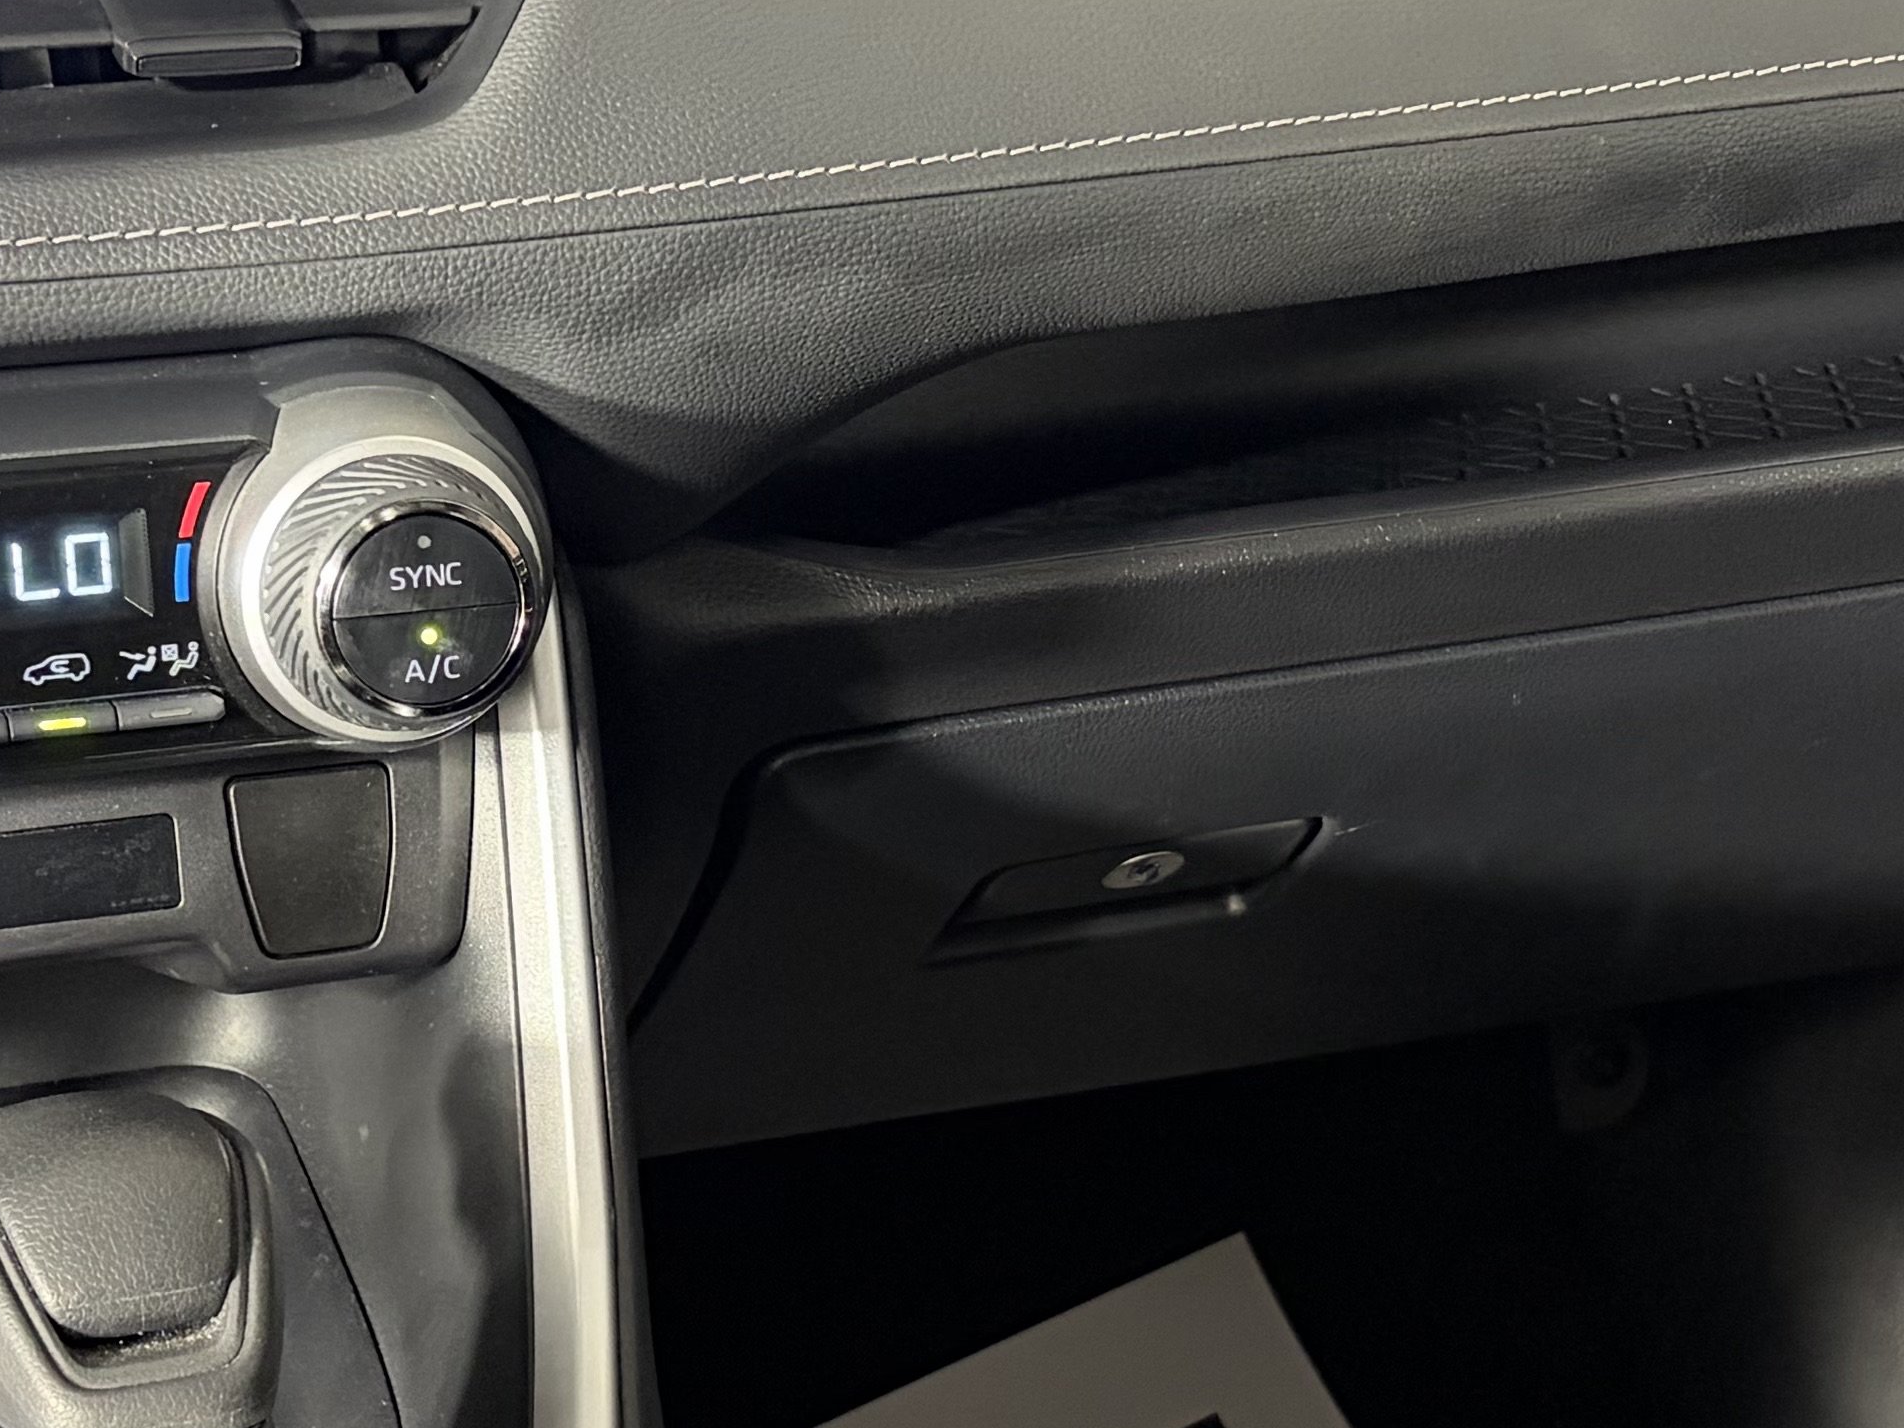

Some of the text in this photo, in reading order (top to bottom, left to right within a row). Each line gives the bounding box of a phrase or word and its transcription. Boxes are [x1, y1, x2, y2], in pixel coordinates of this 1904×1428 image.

[10, 532, 113, 602] LO
[389, 561, 462, 591] SYNC
[405, 654, 461, 684] A/C
